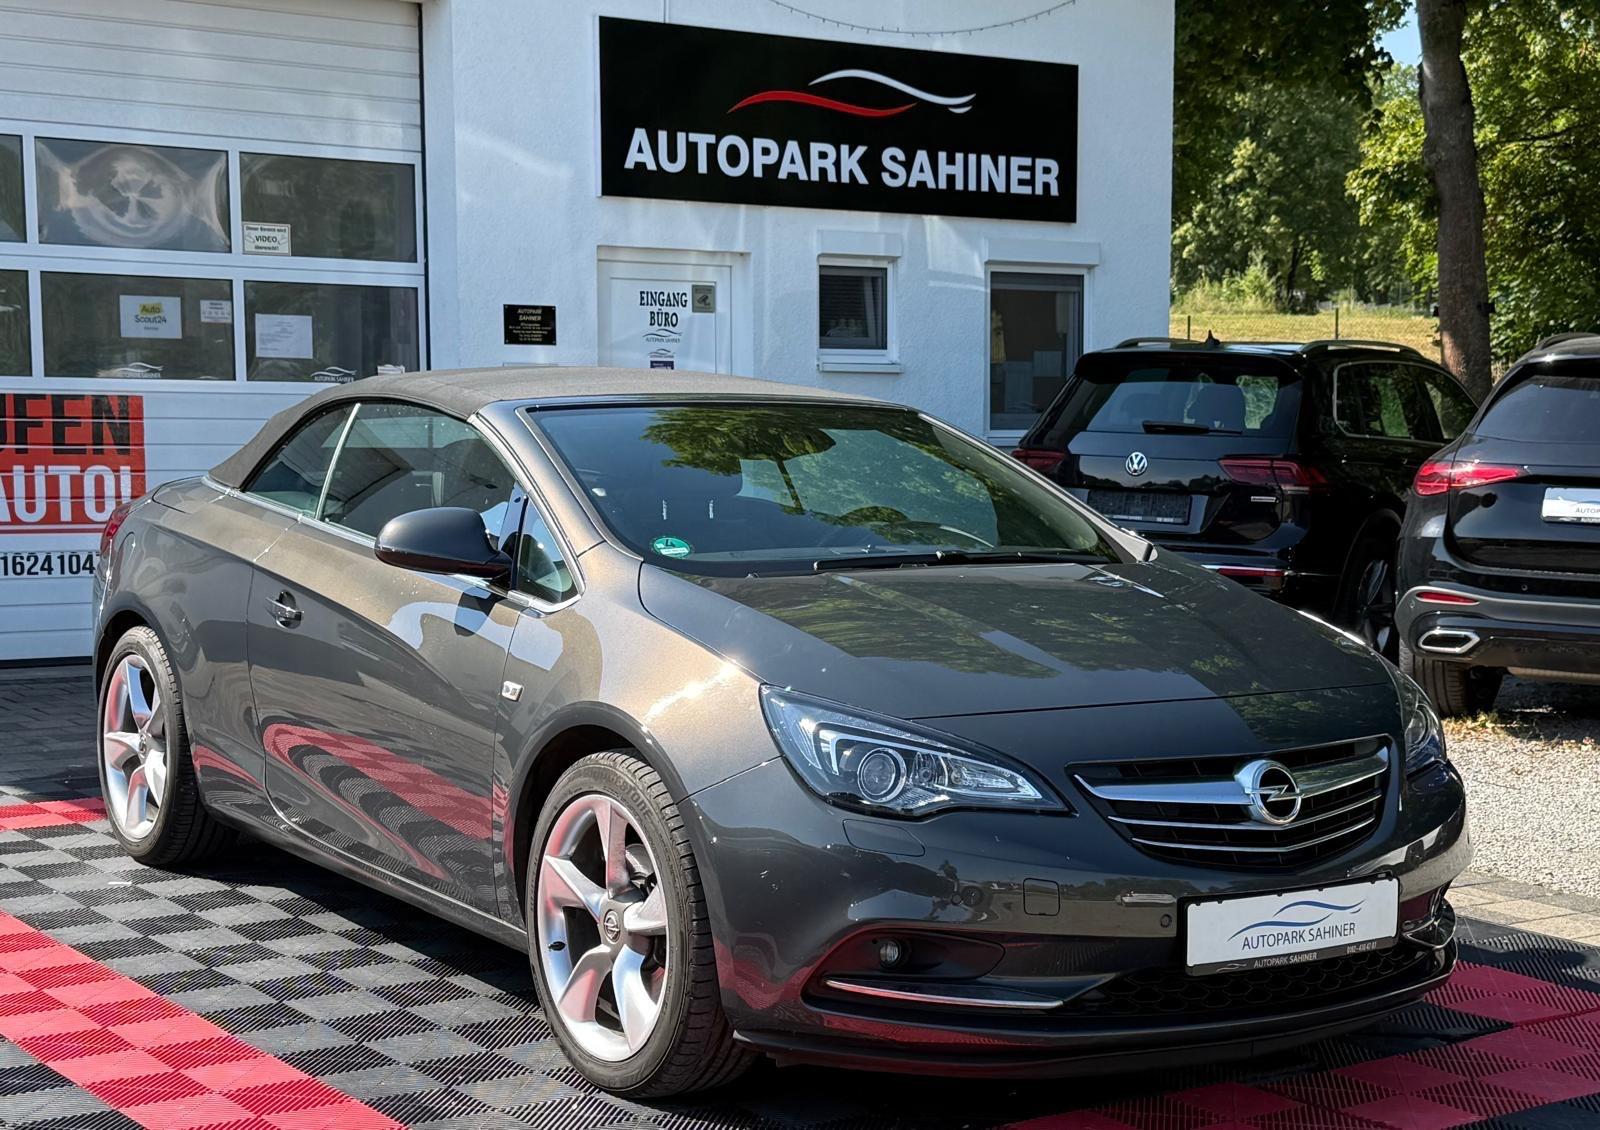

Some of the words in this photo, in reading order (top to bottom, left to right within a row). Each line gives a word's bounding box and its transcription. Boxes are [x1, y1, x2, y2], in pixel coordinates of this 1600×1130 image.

[624, 127, 868, 185] AUTOPARK
[881, 147, 1060, 196] SAHINER
[255, 235, 278, 243] VIDEO
[639, 290, 688, 308] EINGANG
[141, 304, 161, 314] Auto
[649, 308, 679, 328] BÜRO
[134, 314, 167, 324] Scout24
[0, 393, 132, 456] FEN
[0, 551, 101, 577] 1624104
[1241, 929, 1305, 950] AUTOPARK
[1308, 922, 1356, 943] SAHINER
[1253, 956, 1288, 969] AUTOPARK
[1289, 951, 1318, 964] SAHINER
